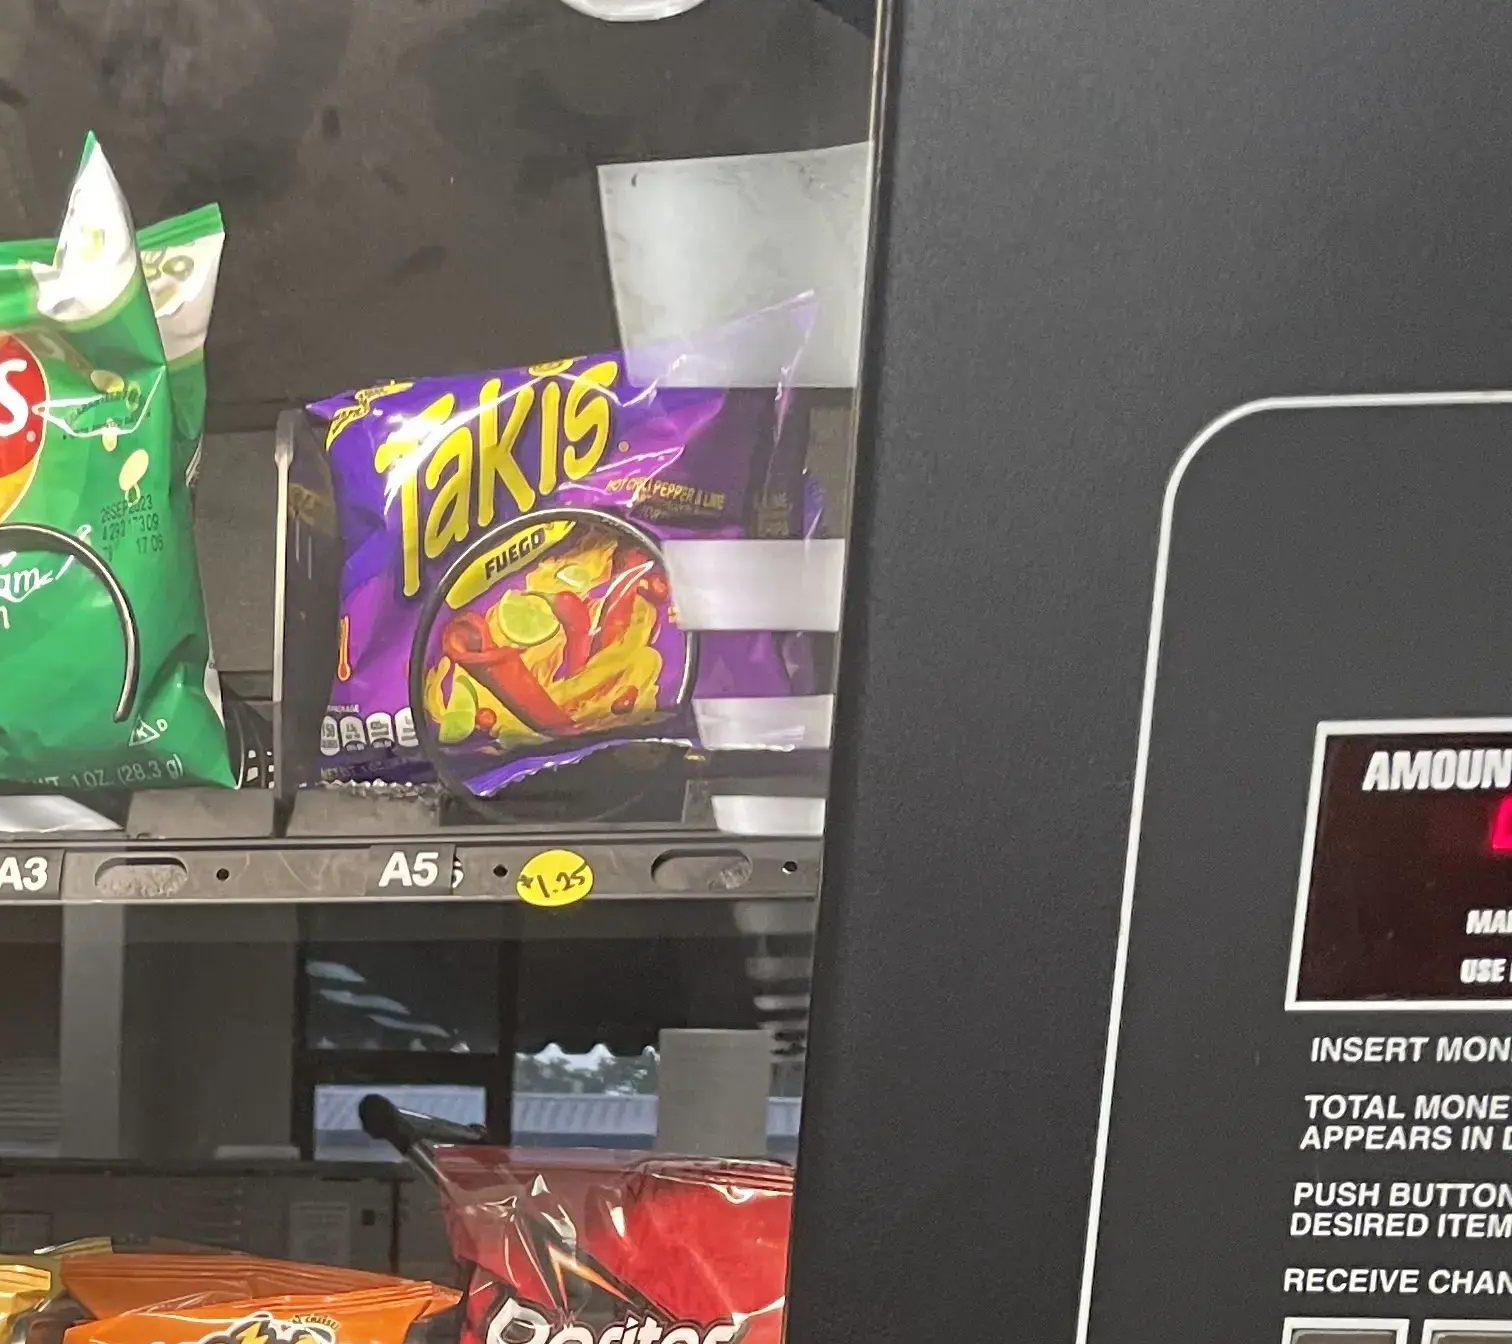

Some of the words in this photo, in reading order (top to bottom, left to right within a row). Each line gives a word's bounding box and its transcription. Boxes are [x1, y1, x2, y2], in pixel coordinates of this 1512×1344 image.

[374, 360, 619, 597] Takis
[654, 480, 694, 504] PEPPER
[484, 527, 546, 581] FUEGO
[378, 852, 439, 888] A5
[1460, 958, 1507, 984] USE
[1310, 1036, 1430, 1063] INSERT
[1435, 1036, 1512, 1063] MON
[1304, 1094, 1406, 1120] TOTAL
[1299, 1125, 1453, 1151] APPEARS
[1460, 1125, 1494, 1151] IN
[1293, 1182, 1381, 1207] PUSH
[1289, 1212, 1430, 1238] DESIRED
[1437, 1213, 1512, 1238] ITEM
[1283, 1267, 1420, 1293] RECEIVE
